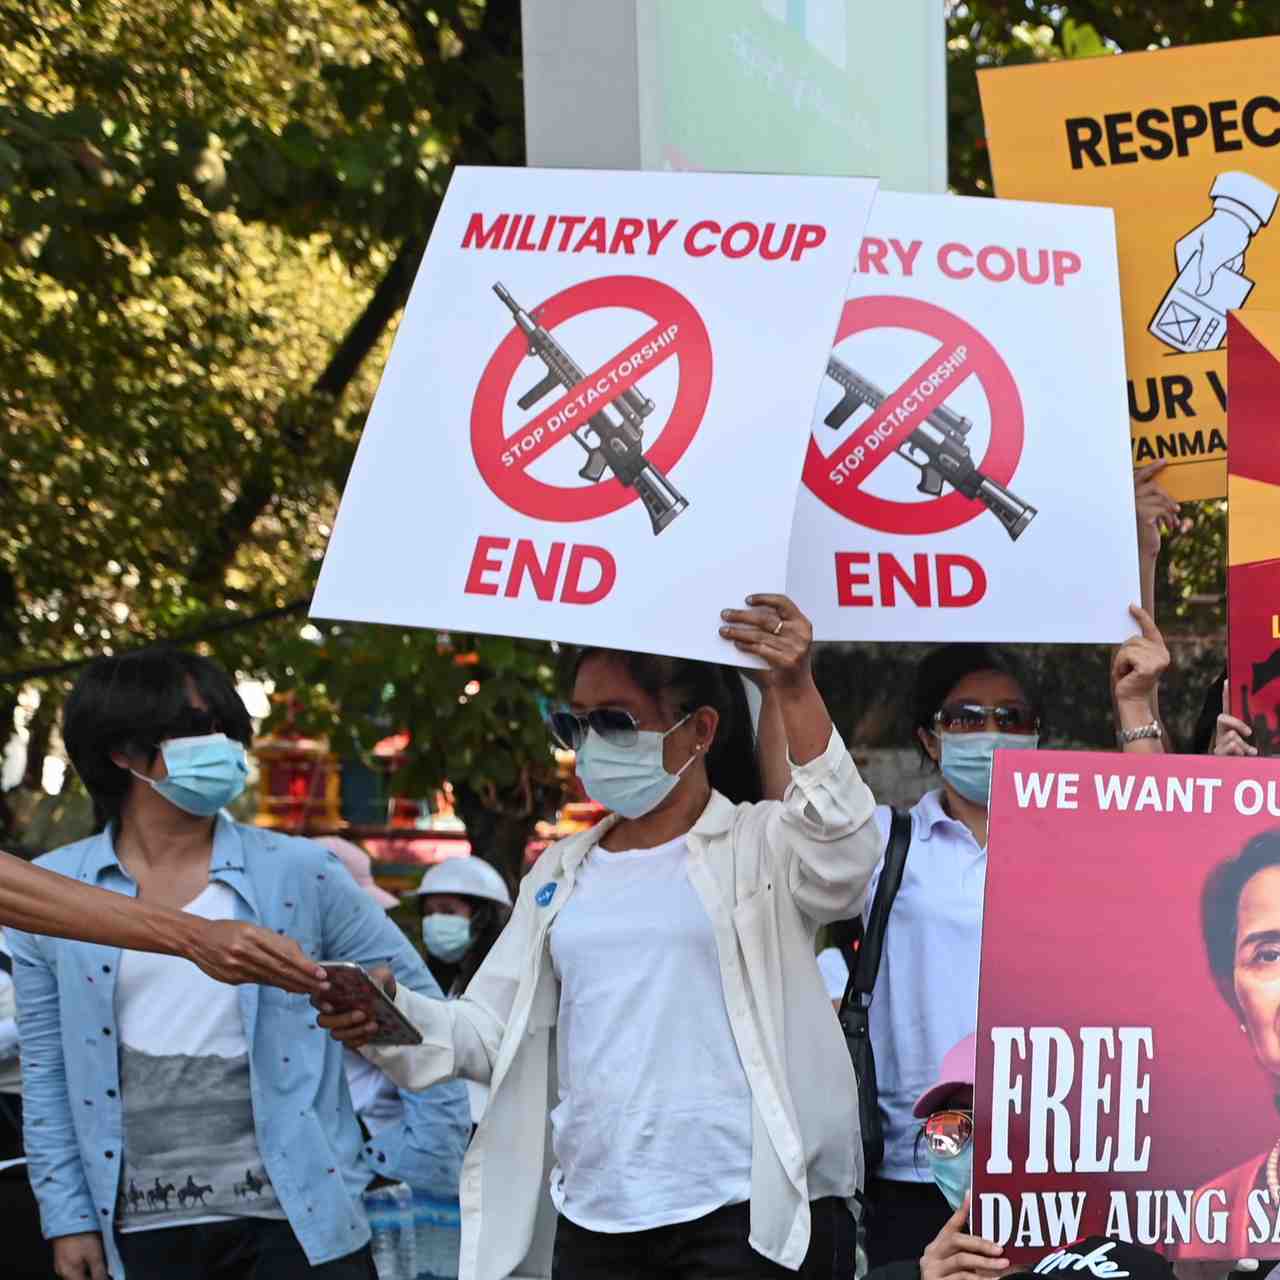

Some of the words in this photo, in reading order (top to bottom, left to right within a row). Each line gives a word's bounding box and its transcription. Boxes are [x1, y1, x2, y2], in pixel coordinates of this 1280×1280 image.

[460, 213, 678, 256] MILITARY
[683, 220, 827, 261] COUP
[854, 237, 923, 277] RY
[937, 243, 1082, 286] COUP
[501, 427, 545, 467] STOP
[546, 323, 679, 433] DICTACTORSHIP
[829, 445, 865, 486] STOP
[864, 344, 969, 451] DICTACTORSHIP
[1127, 374, 1197, 423] UR
[1131, 428, 1227, 461] ANMA
[463, 536, 618, 606] END
[834, 551, 988, 608] END
[1013, 772, 1079, 810] WE
[1094, 774, 1222, 814] WANT
[986, 1026, 1154, 1175] FREE
[979, 1192, 1088, 1249] DAW
[1104, 1190, 1229, 1247] AUNG
